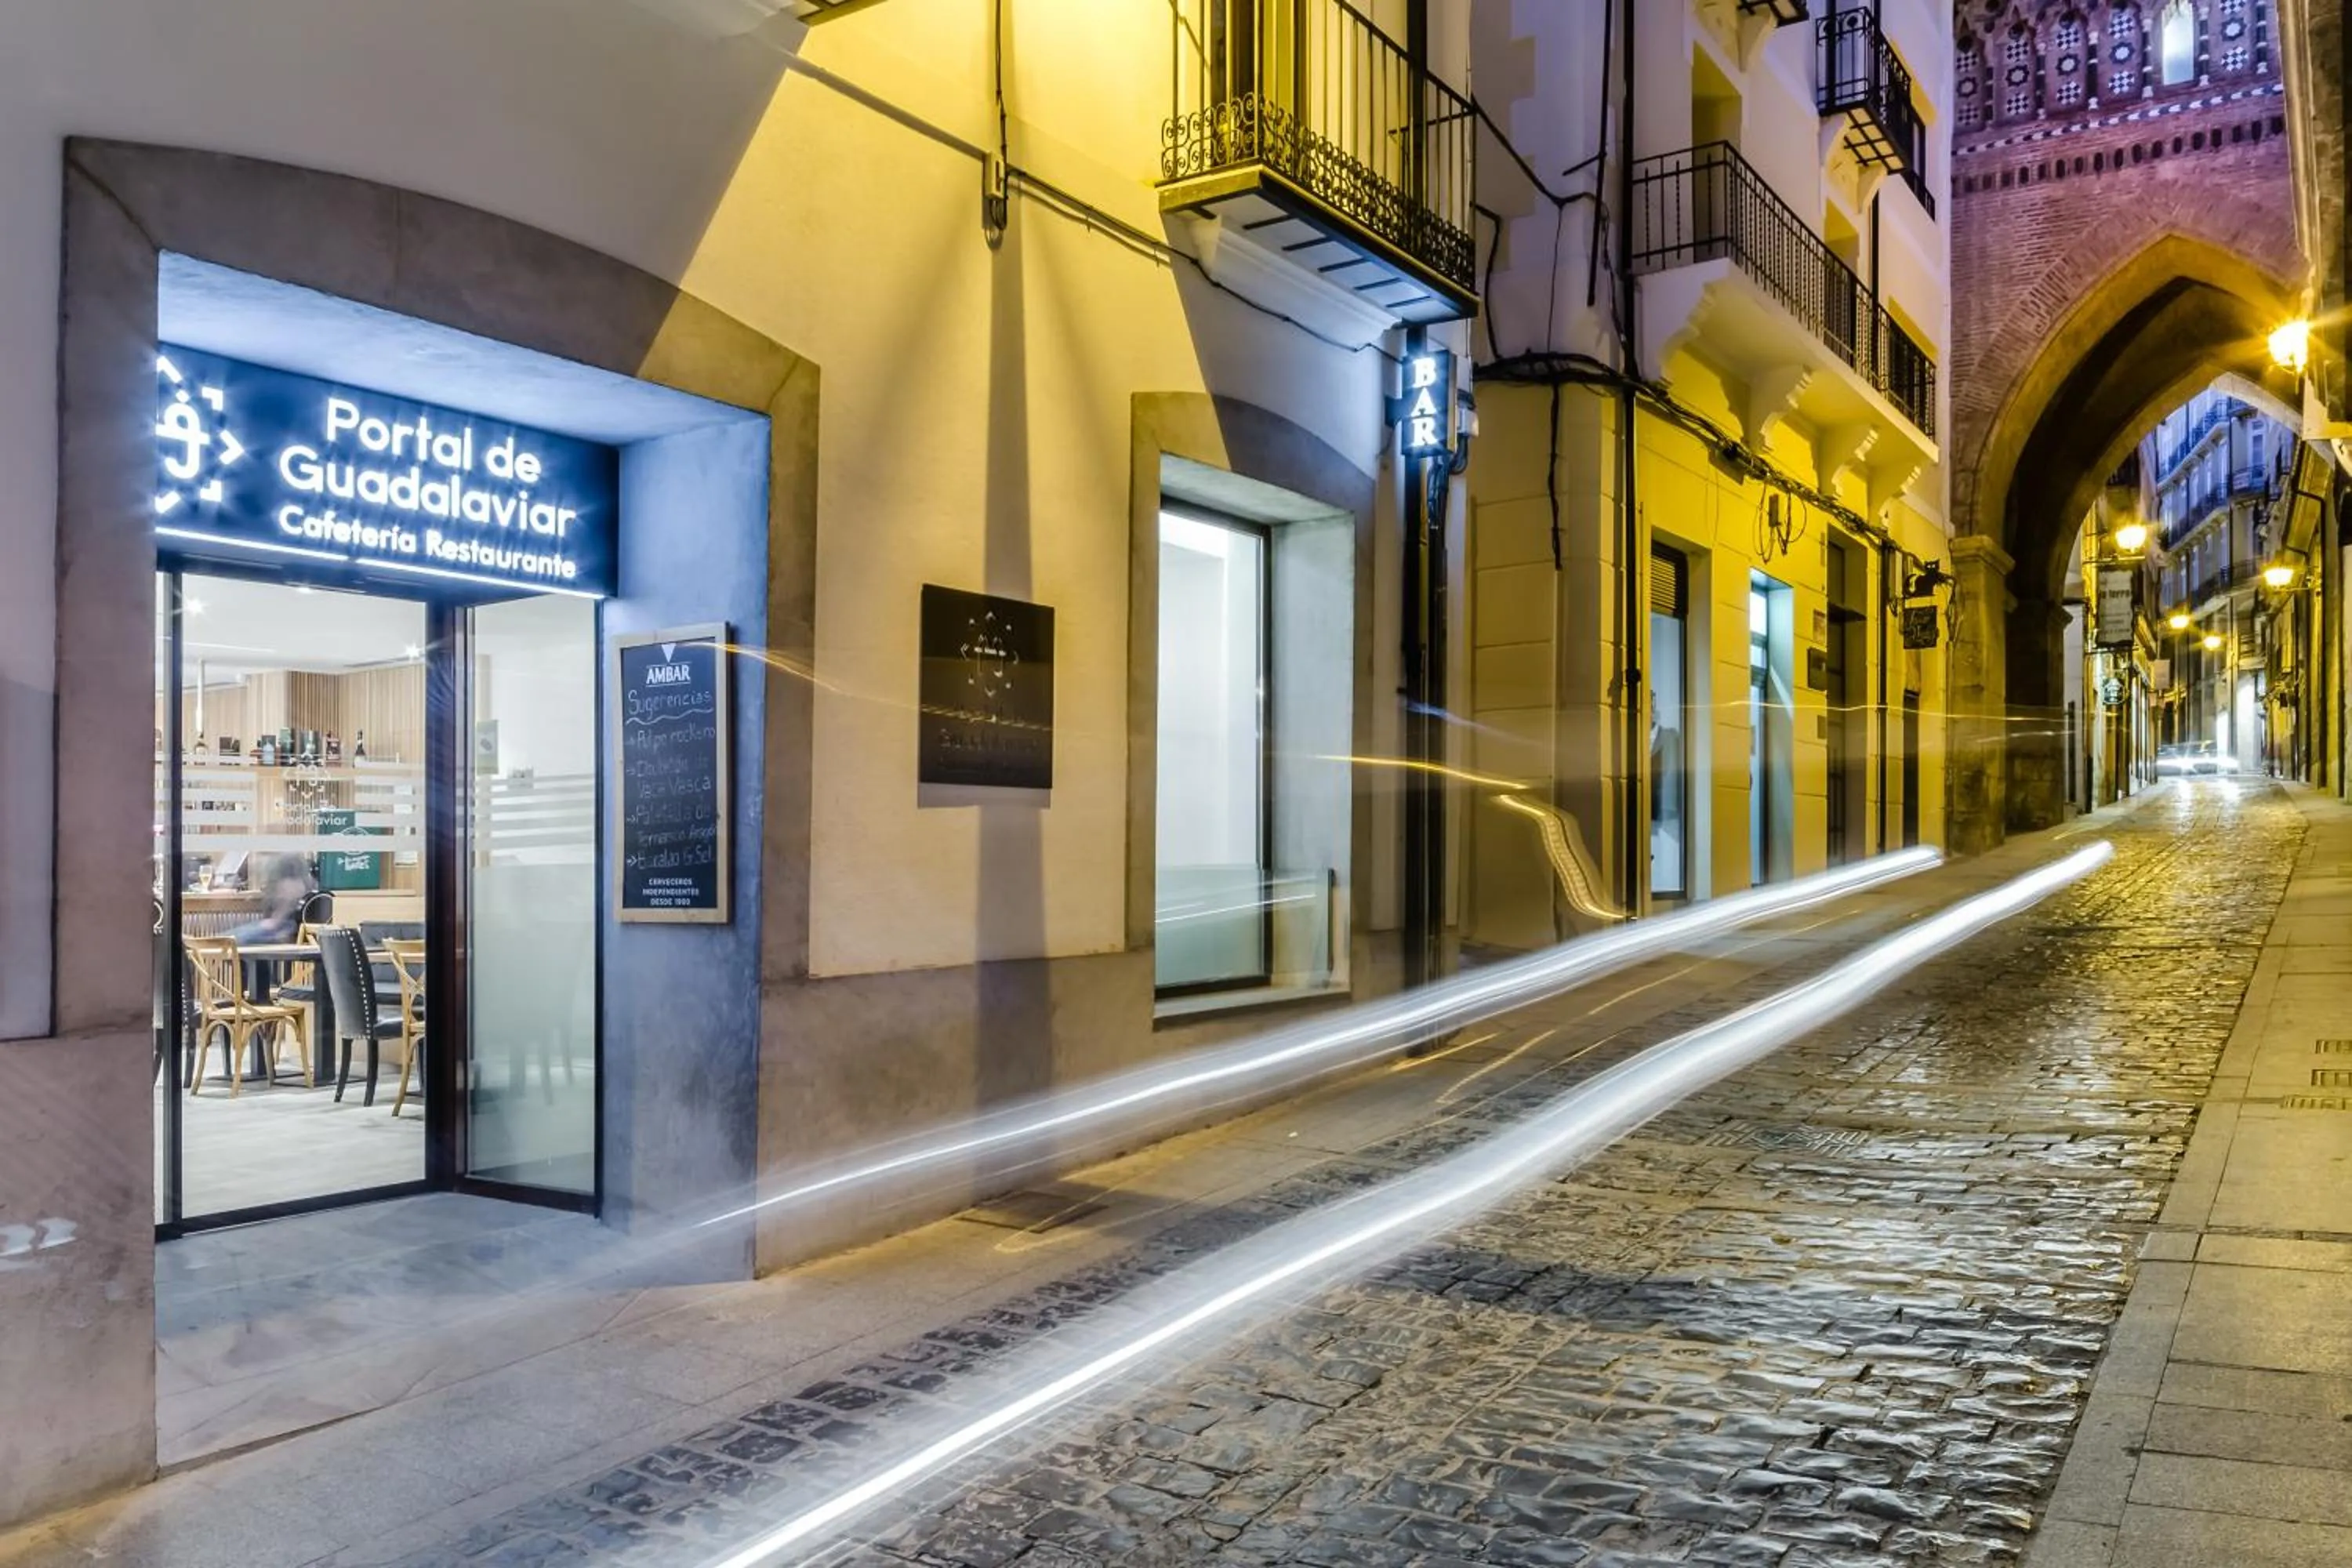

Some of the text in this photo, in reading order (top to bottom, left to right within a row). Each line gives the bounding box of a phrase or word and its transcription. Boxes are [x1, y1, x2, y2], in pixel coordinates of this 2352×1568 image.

[1411, 357, 1438, 446] BAR
[327, 397, 543, 483] Portal de
[280, 445, 577, 537] Guadalaviar
[279, 506, 577, 579] Cafetería Restaurante
[646, 664, 691, 684] AMBAR
[628, 689, 713, 720] Sugerencias
[642, 887, 699, 896] INDEPENDIENTES
[648, 877, 692, 886] CERVECEROS
